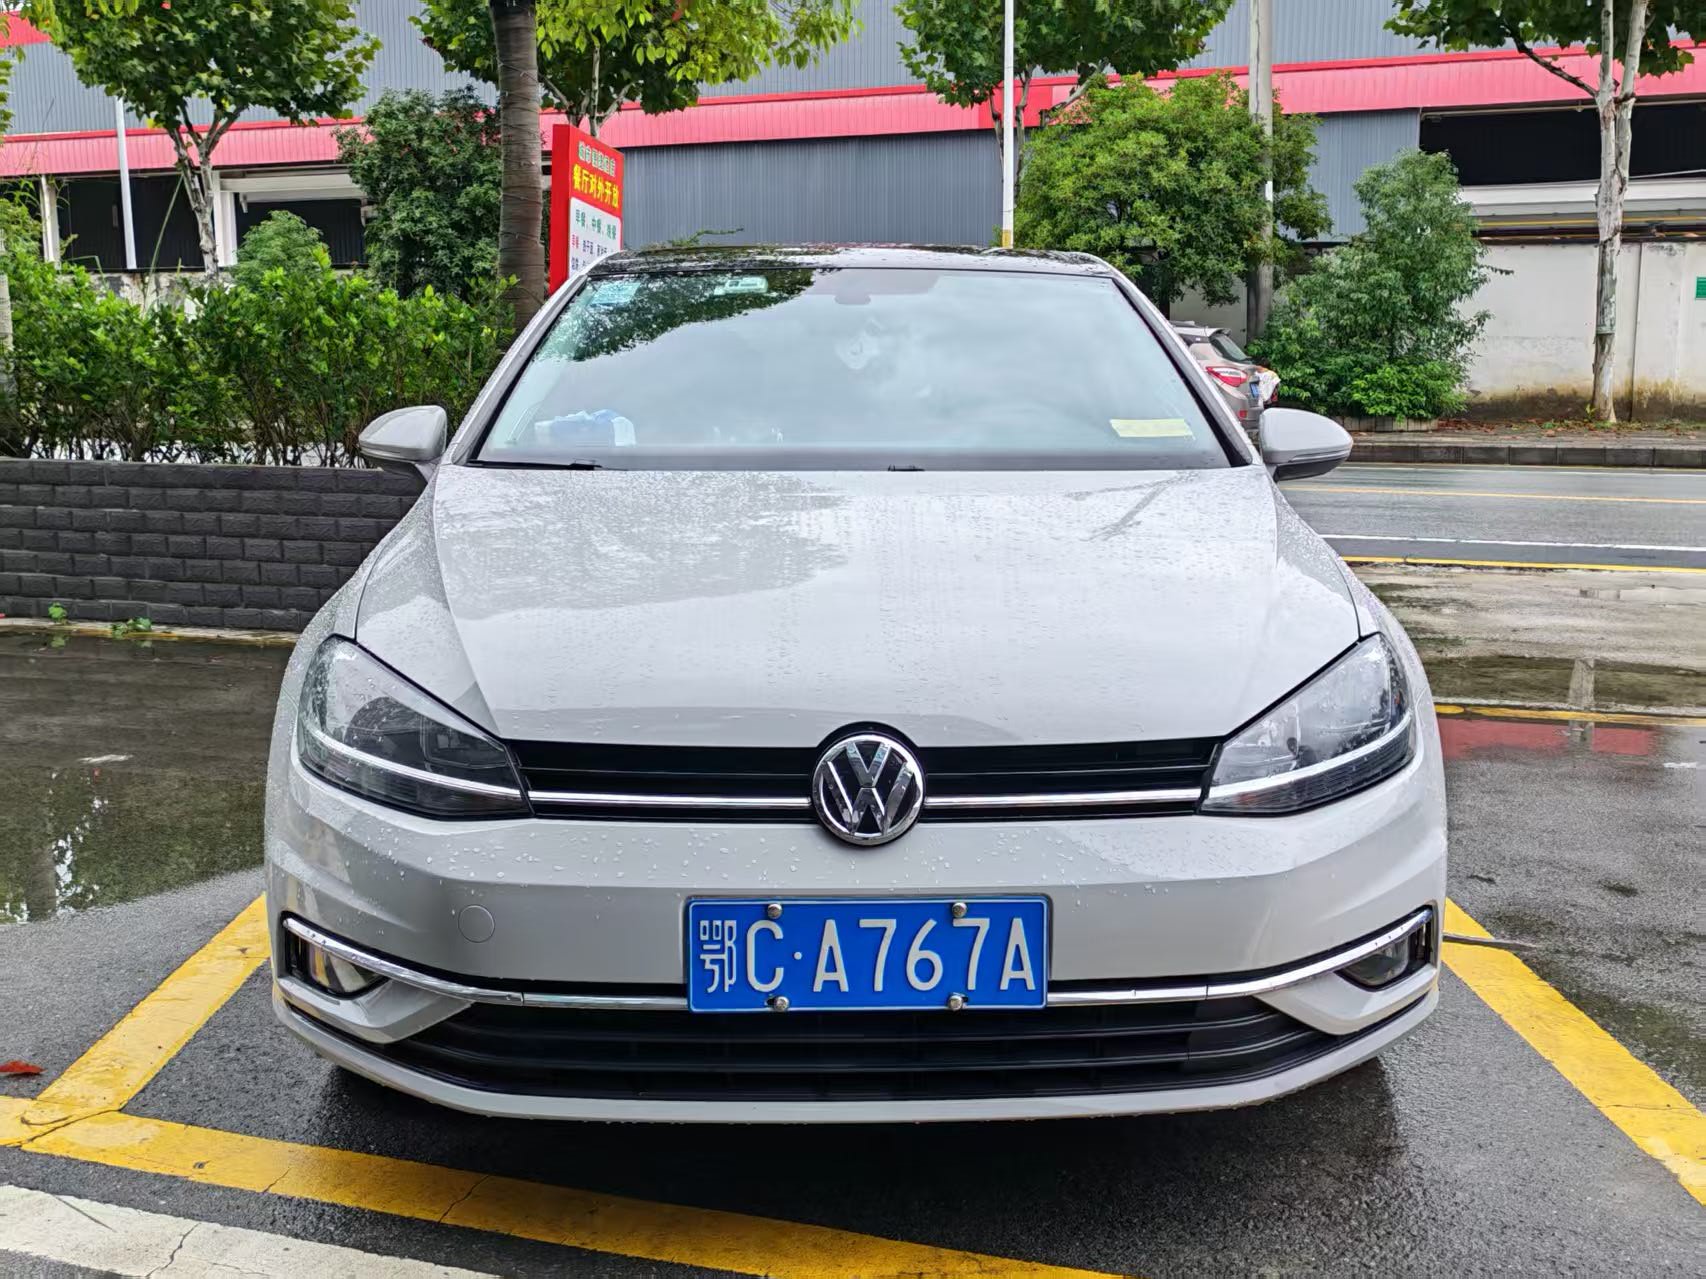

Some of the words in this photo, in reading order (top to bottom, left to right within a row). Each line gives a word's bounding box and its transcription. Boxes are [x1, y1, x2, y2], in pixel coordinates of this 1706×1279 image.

[573, 163, 619, 208] 餐厅对外开放
[700, 918, 1036, 993] 鄂C·A767A
